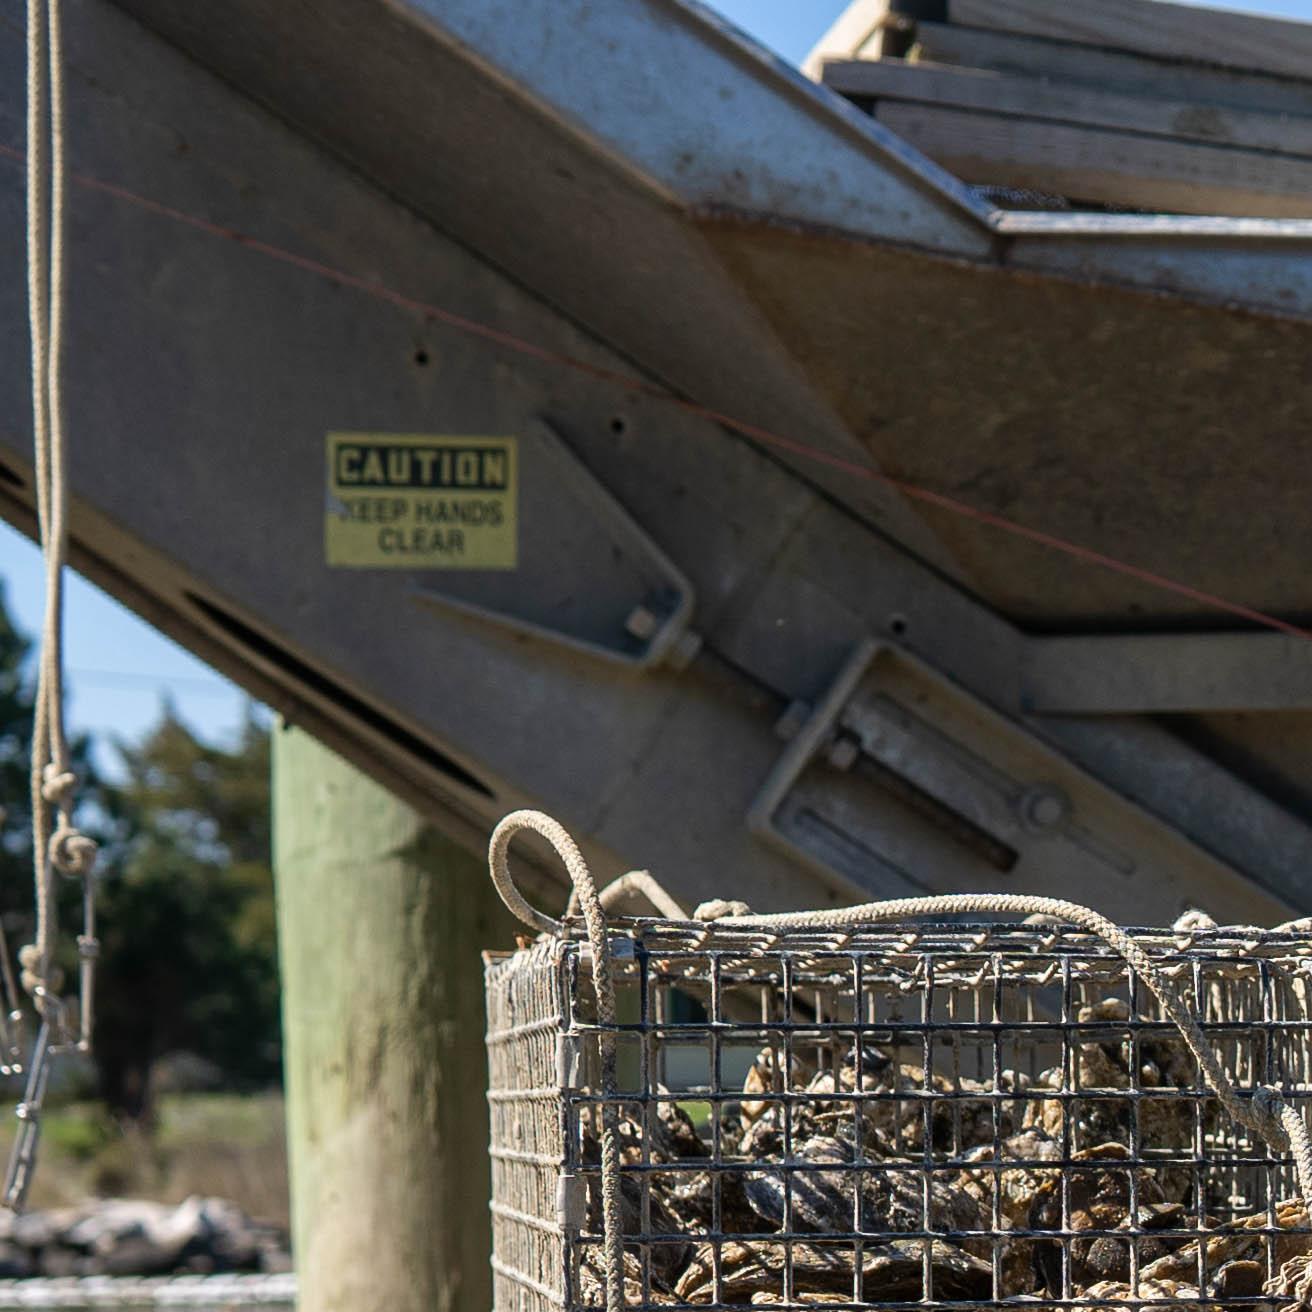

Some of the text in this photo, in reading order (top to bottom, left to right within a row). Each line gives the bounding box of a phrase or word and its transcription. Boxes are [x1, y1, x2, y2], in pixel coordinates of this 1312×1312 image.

[339, 448, 503, 486] CAUTION
[415, 498, 504, 527] HANDS
[377, 526, 465, 556] CLEAR
